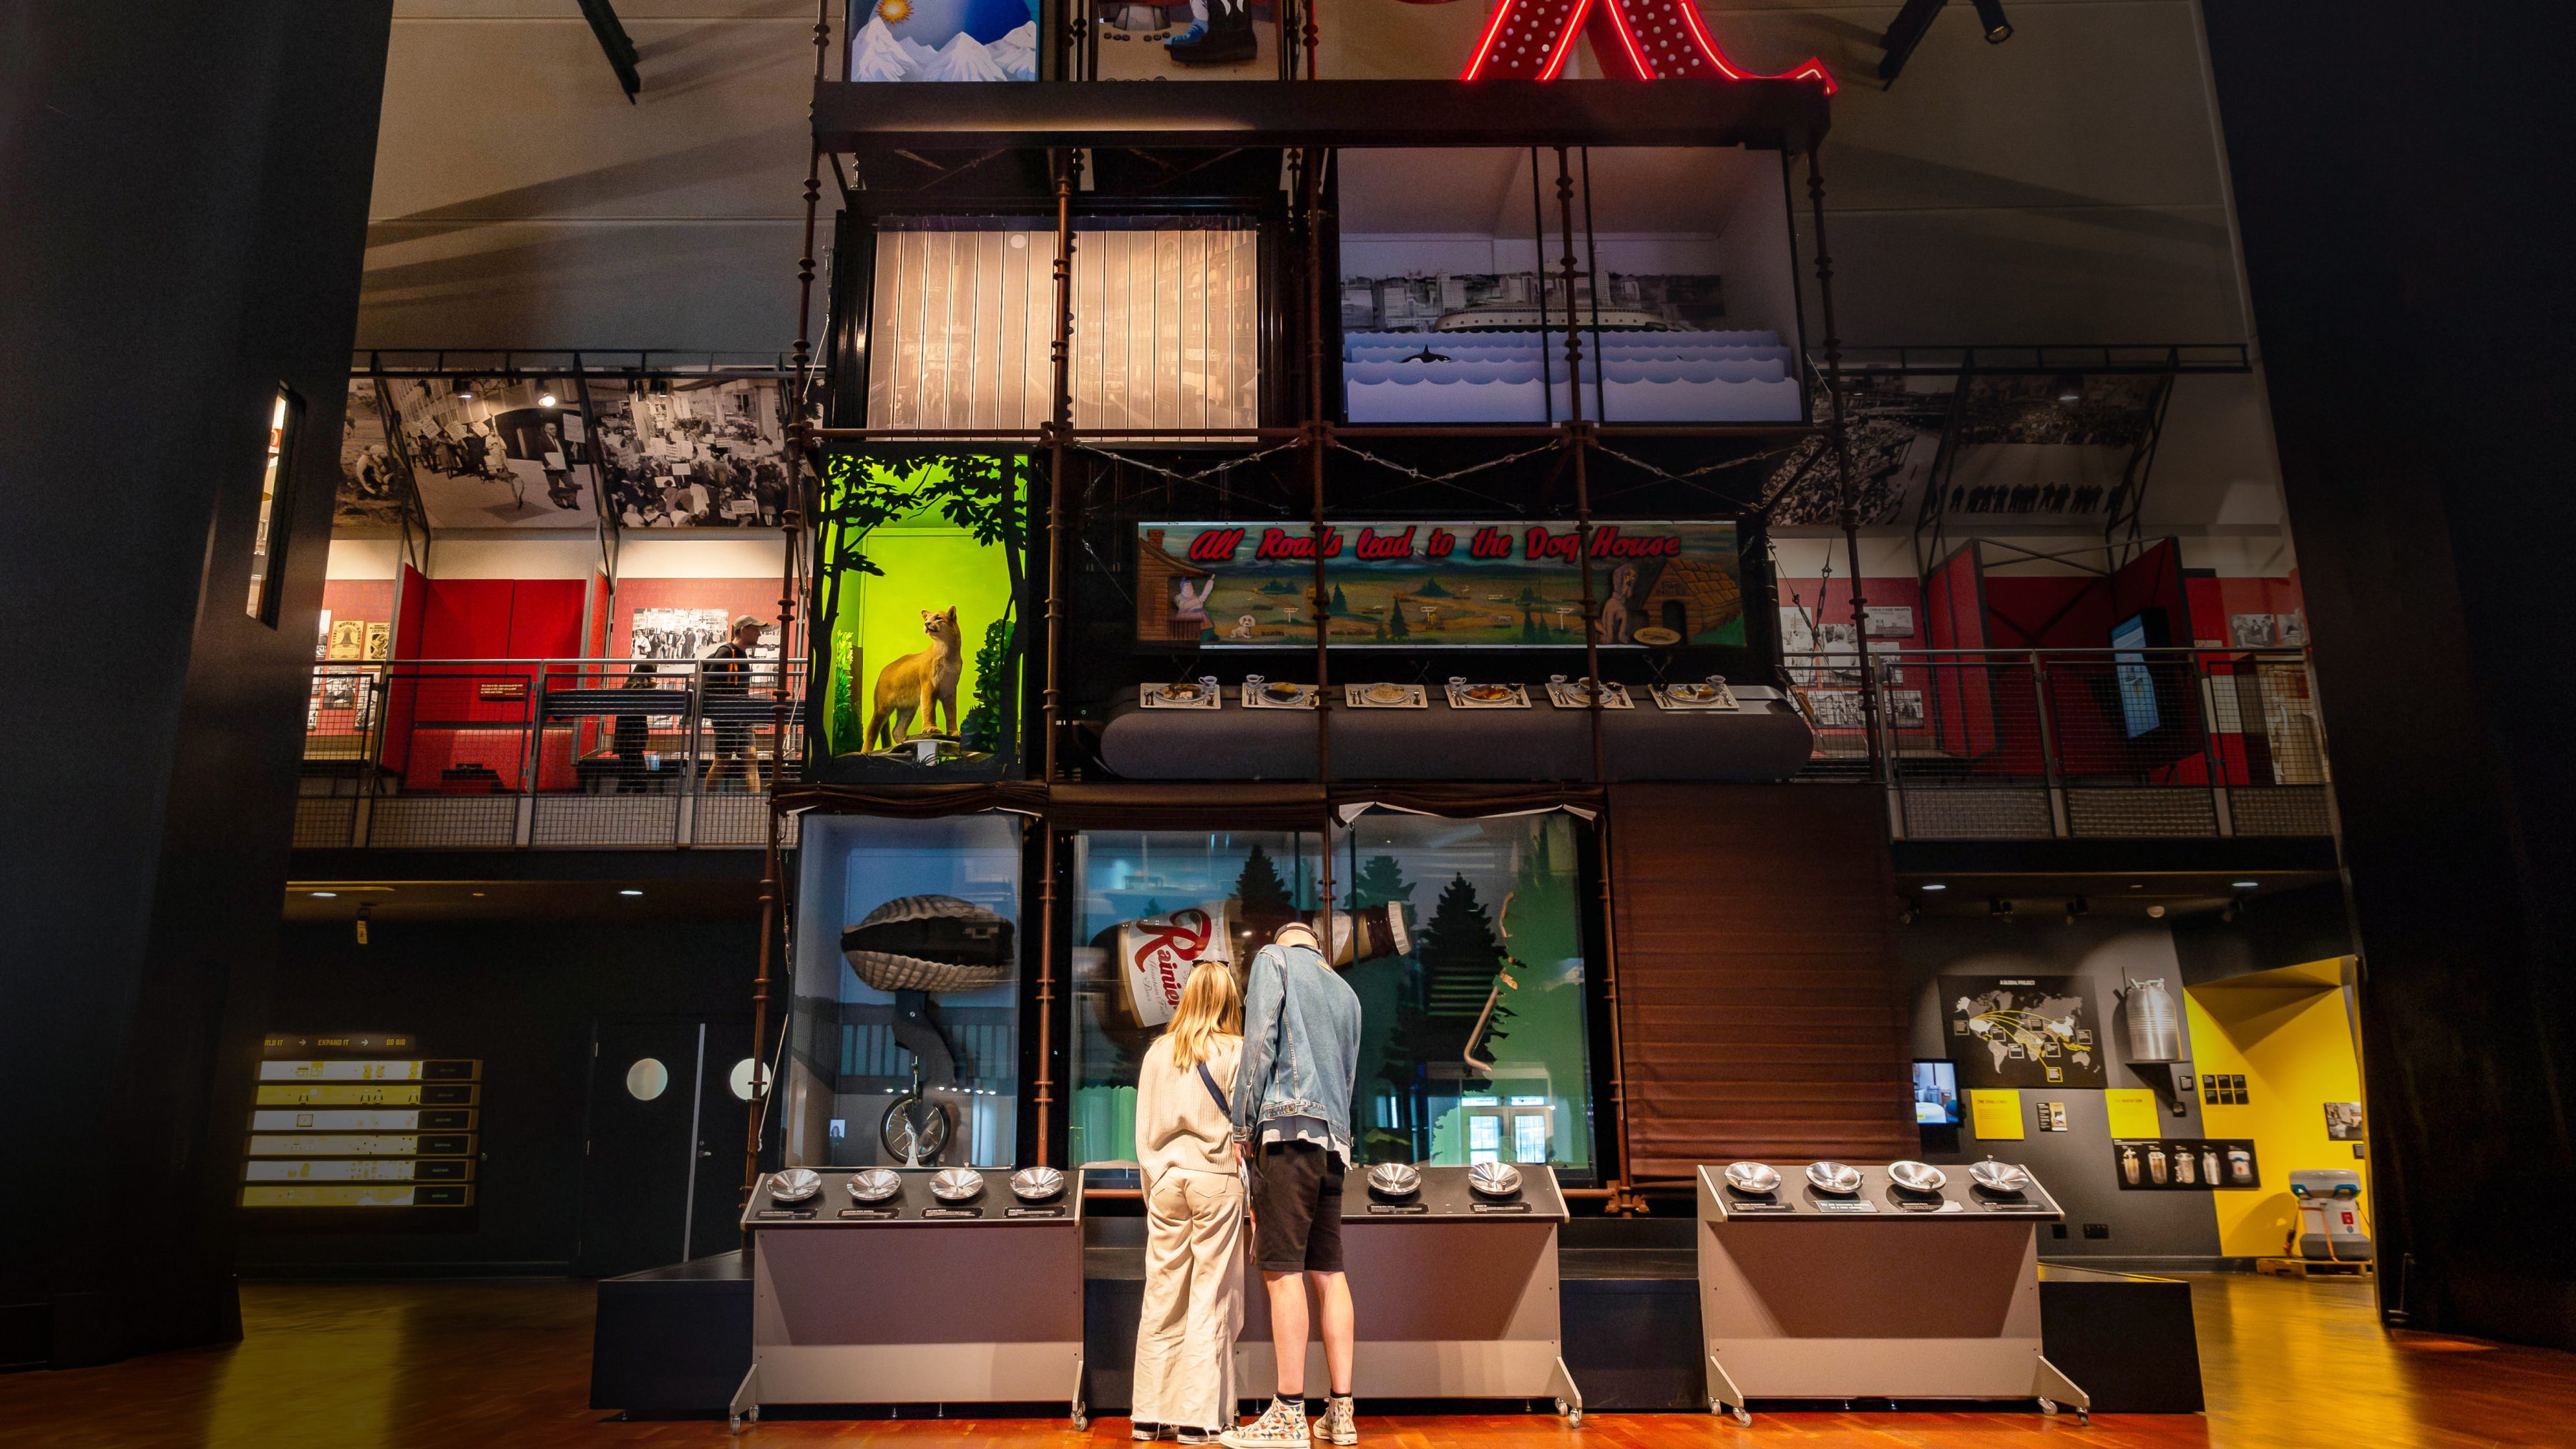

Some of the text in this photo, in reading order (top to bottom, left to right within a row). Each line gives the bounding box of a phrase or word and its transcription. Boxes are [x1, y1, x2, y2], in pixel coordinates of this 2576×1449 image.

[1189, 528, 1244, 560] All
[1256, 526, 1343, 560] Roads
[1356, 526, 1416, 560] lead
[1428, 527, 1455, 558] to
[1471, 527, 1513, 559] the
[1590, 526, 1681, 558] House
[623, 592, 679, 603] RACIAL
